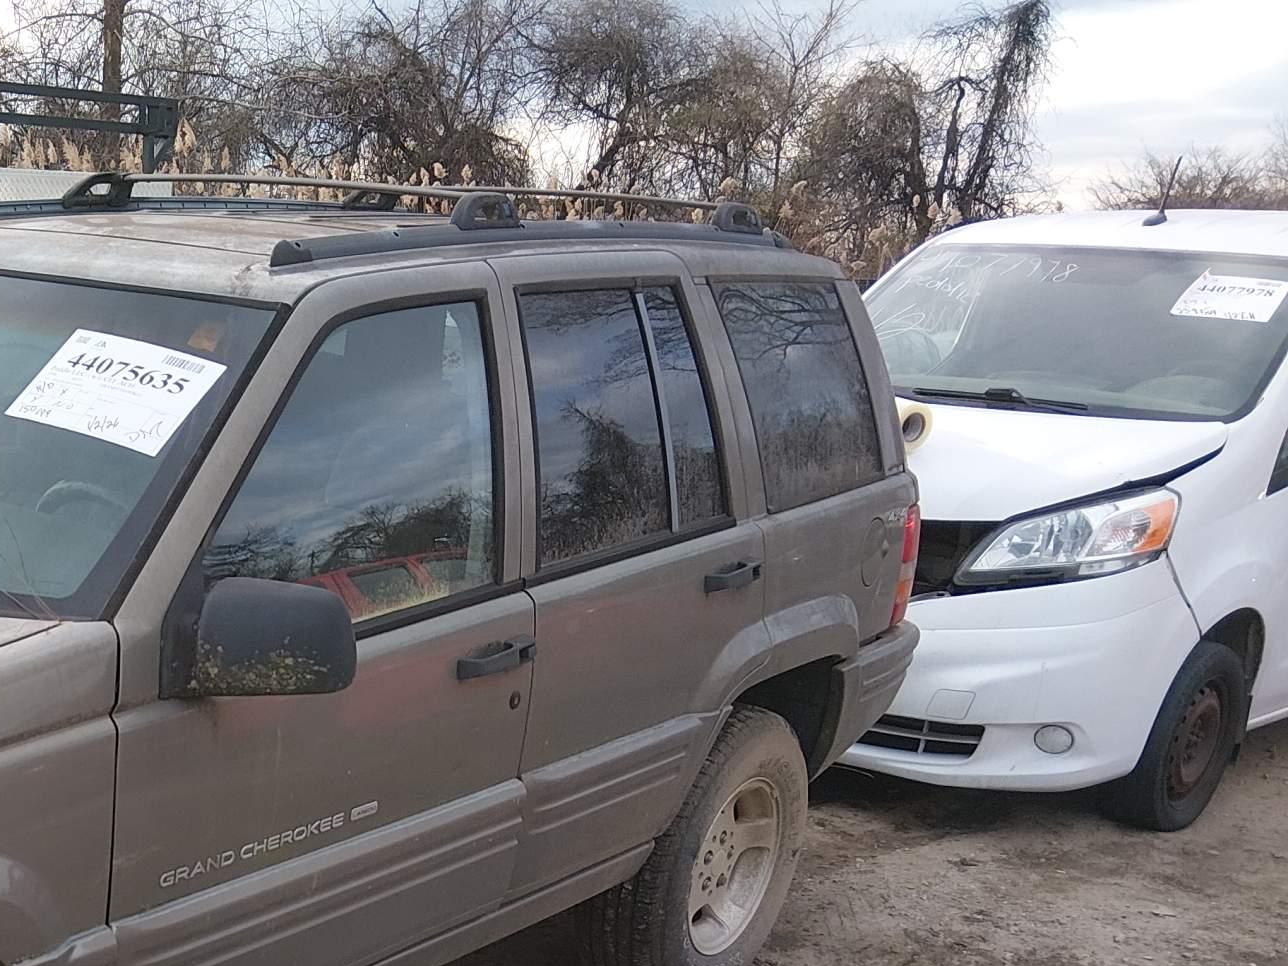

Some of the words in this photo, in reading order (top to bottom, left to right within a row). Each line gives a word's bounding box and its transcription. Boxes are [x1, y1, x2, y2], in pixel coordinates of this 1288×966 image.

[67, 352, 191, 394] 44075635
[160, 850, 236, 888] GRAND
[240, 812, 345, 860] CHEROKEE
